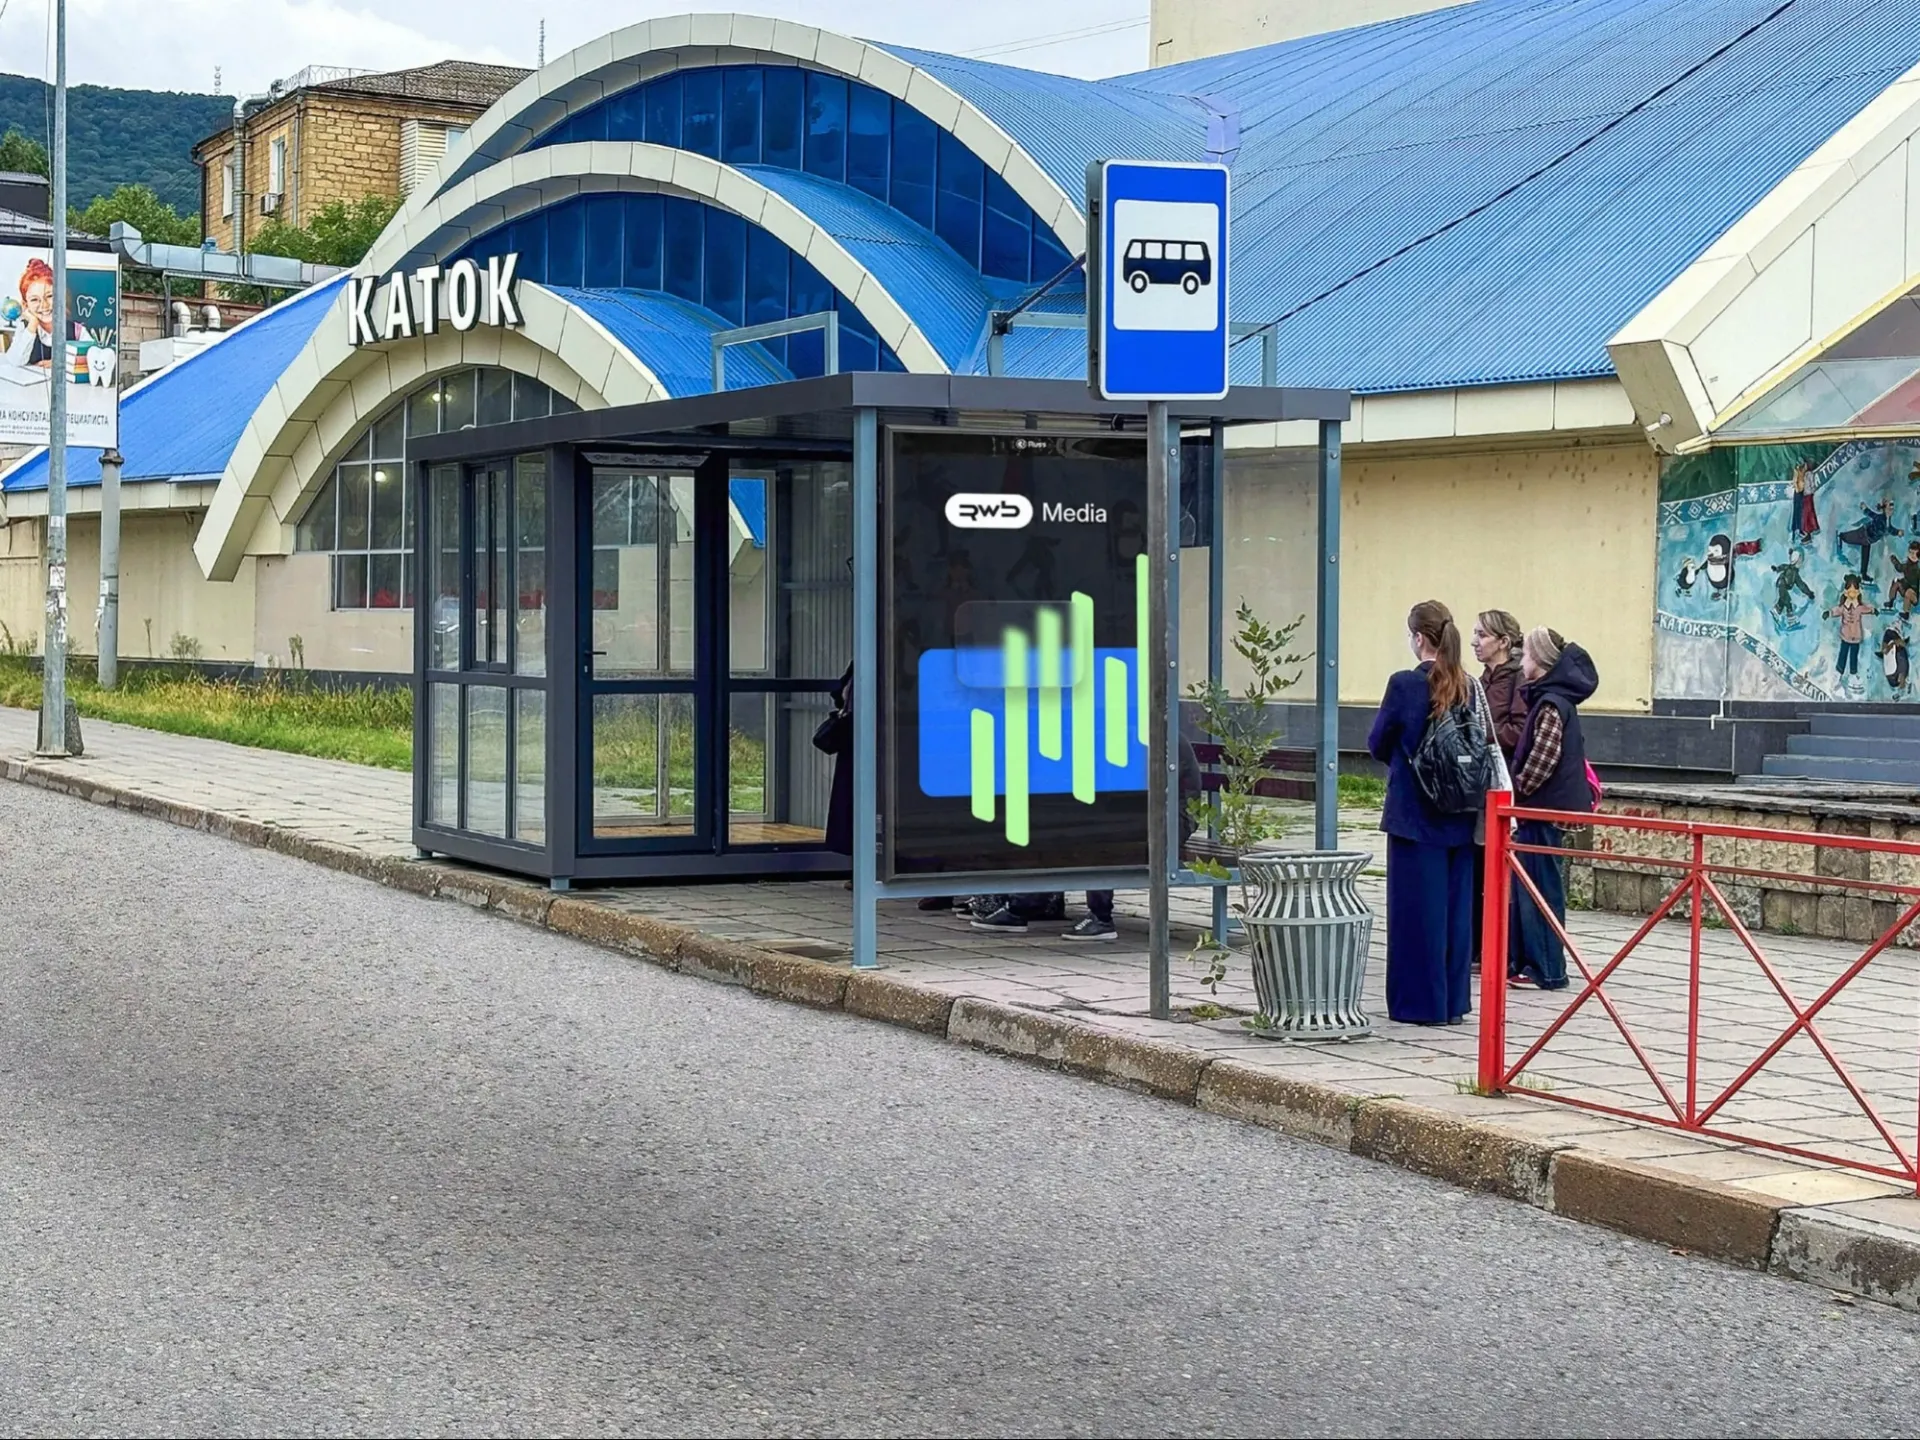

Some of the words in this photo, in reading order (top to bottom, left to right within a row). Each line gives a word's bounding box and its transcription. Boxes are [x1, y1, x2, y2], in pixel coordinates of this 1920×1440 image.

[348, 252, 524, 345] КАТОК
[1814, 456, 1840, 488] АТОК
[1042, 502, 1107, 523] Media
[1659, 614, 1701, 637] КАТОК
